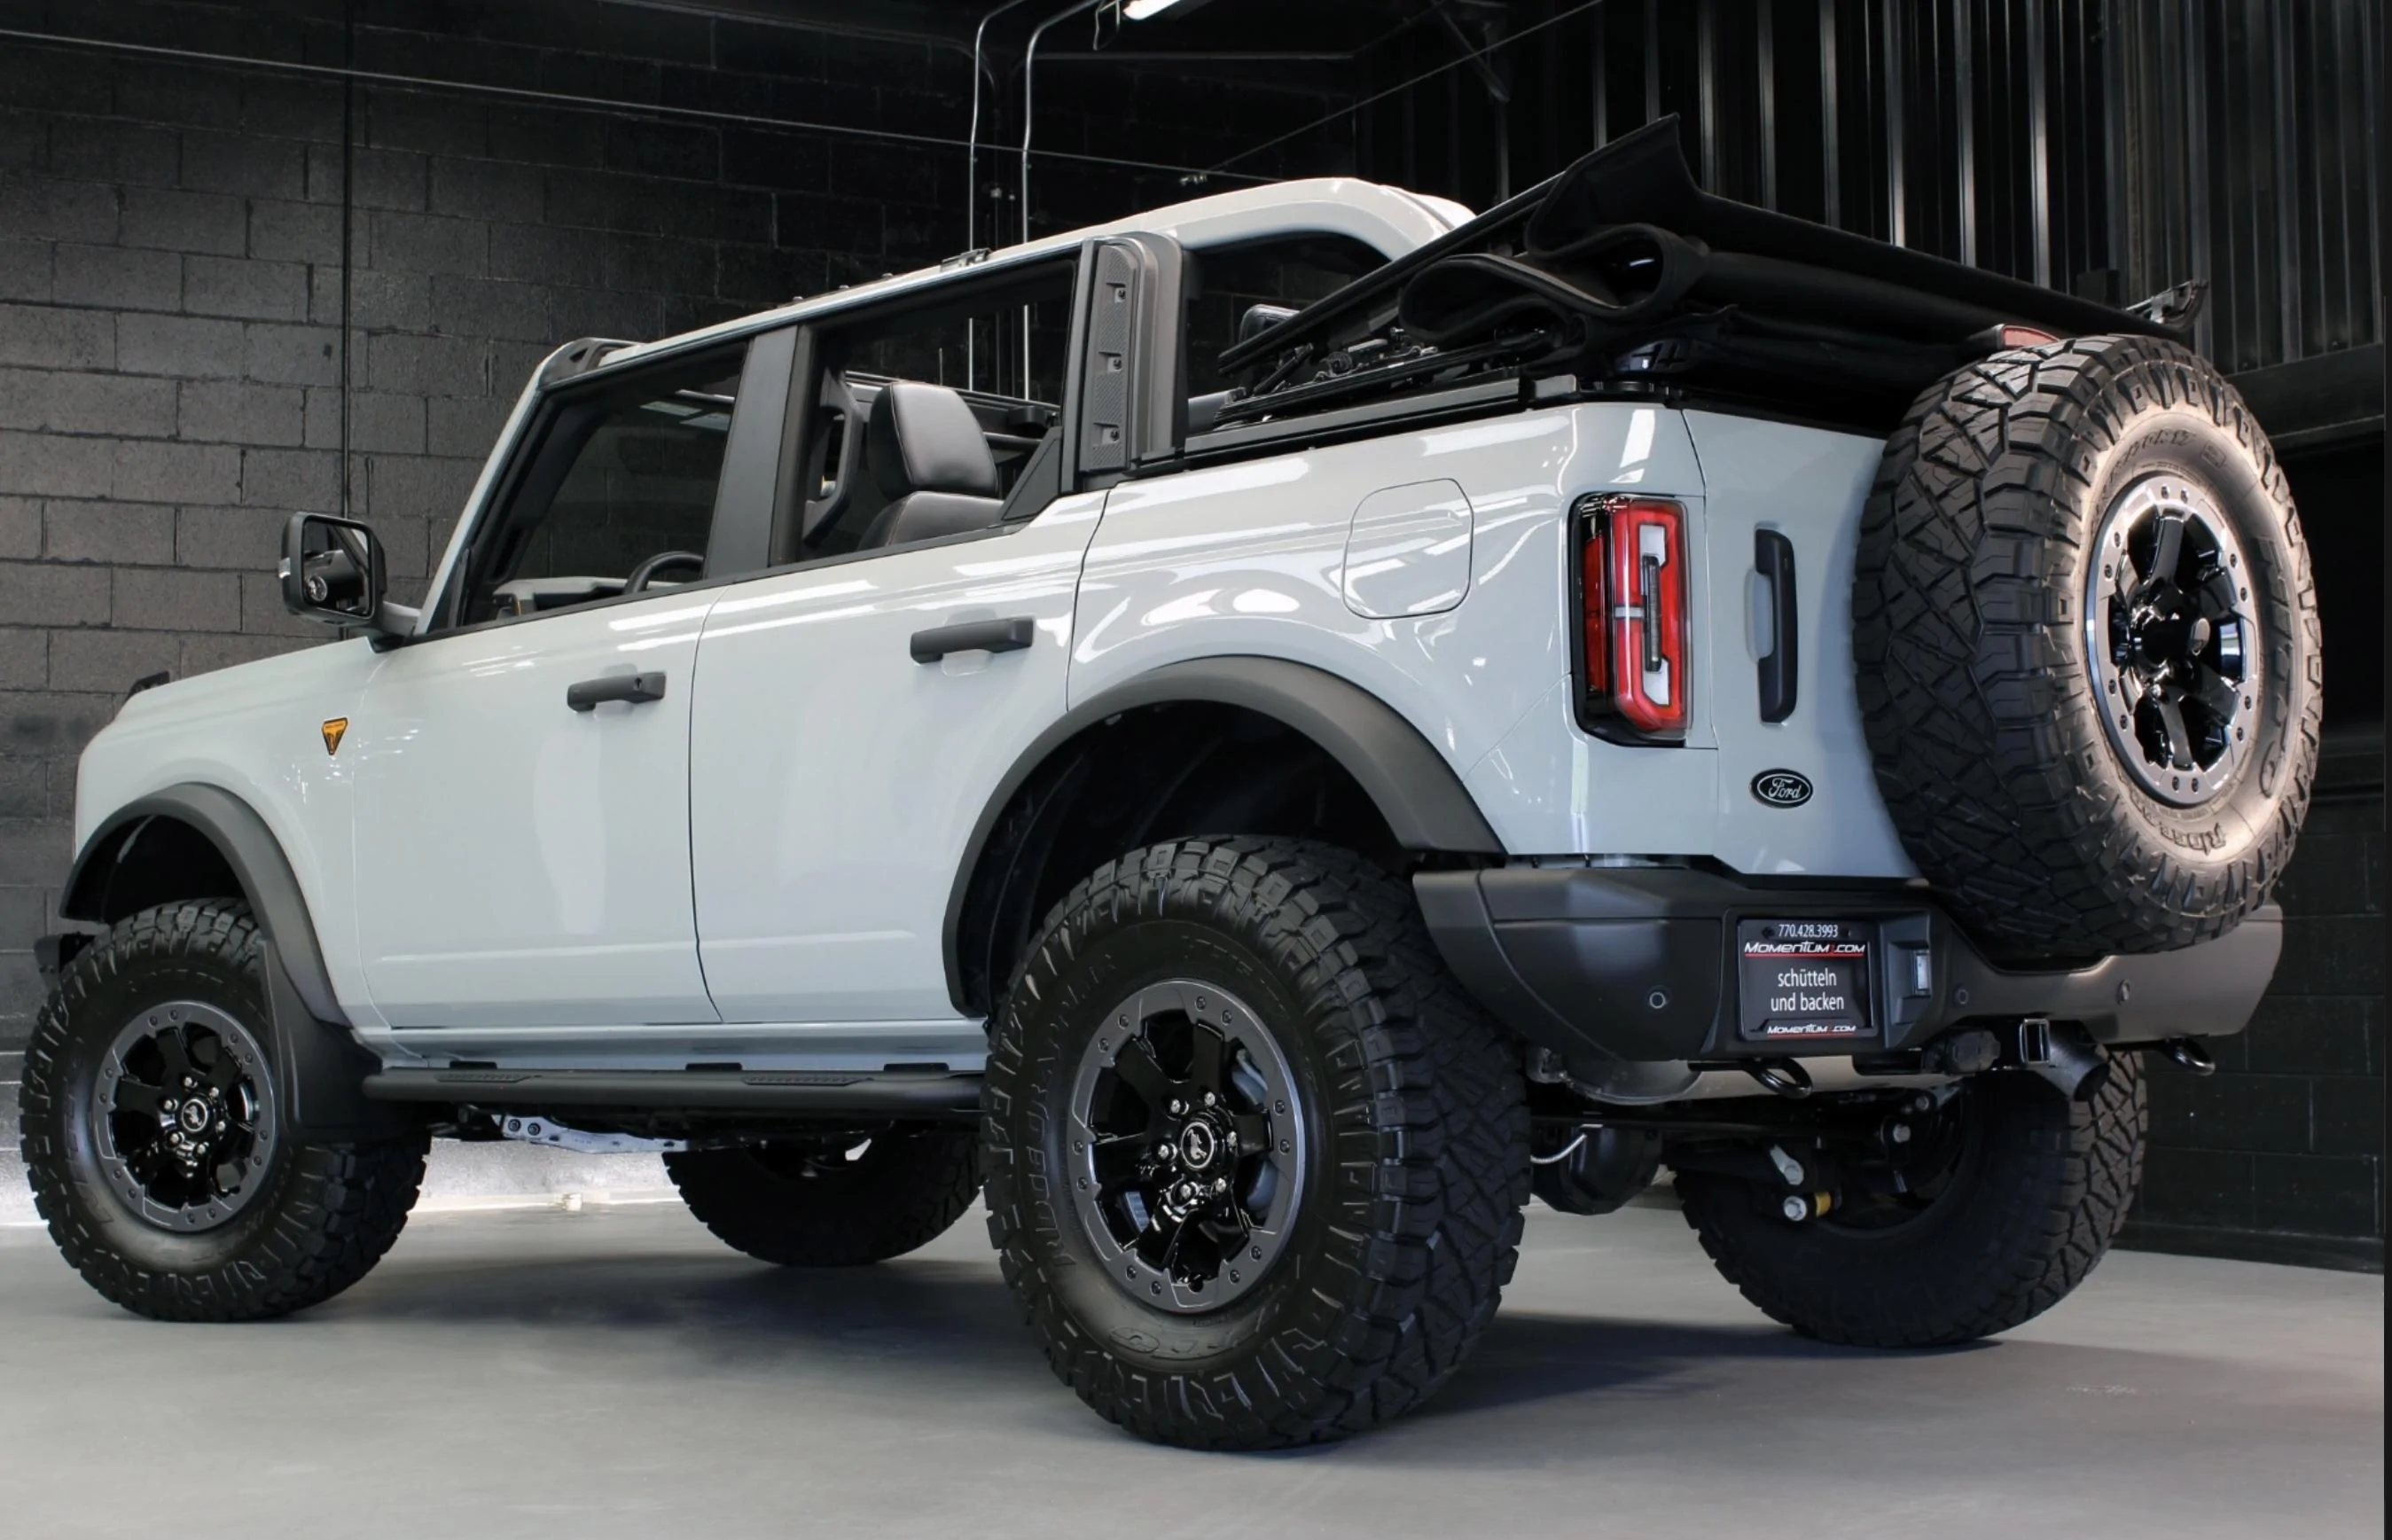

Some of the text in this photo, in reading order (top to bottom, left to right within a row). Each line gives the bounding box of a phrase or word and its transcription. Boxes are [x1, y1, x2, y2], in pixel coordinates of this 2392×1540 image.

[1768, 778, 1802, 799] Ford
[1778, 924, 1839, 938] 770.428.3993
[1778, 968, 1837, 988] schütteln
[1771, 992, 1845, 1012] und backen
